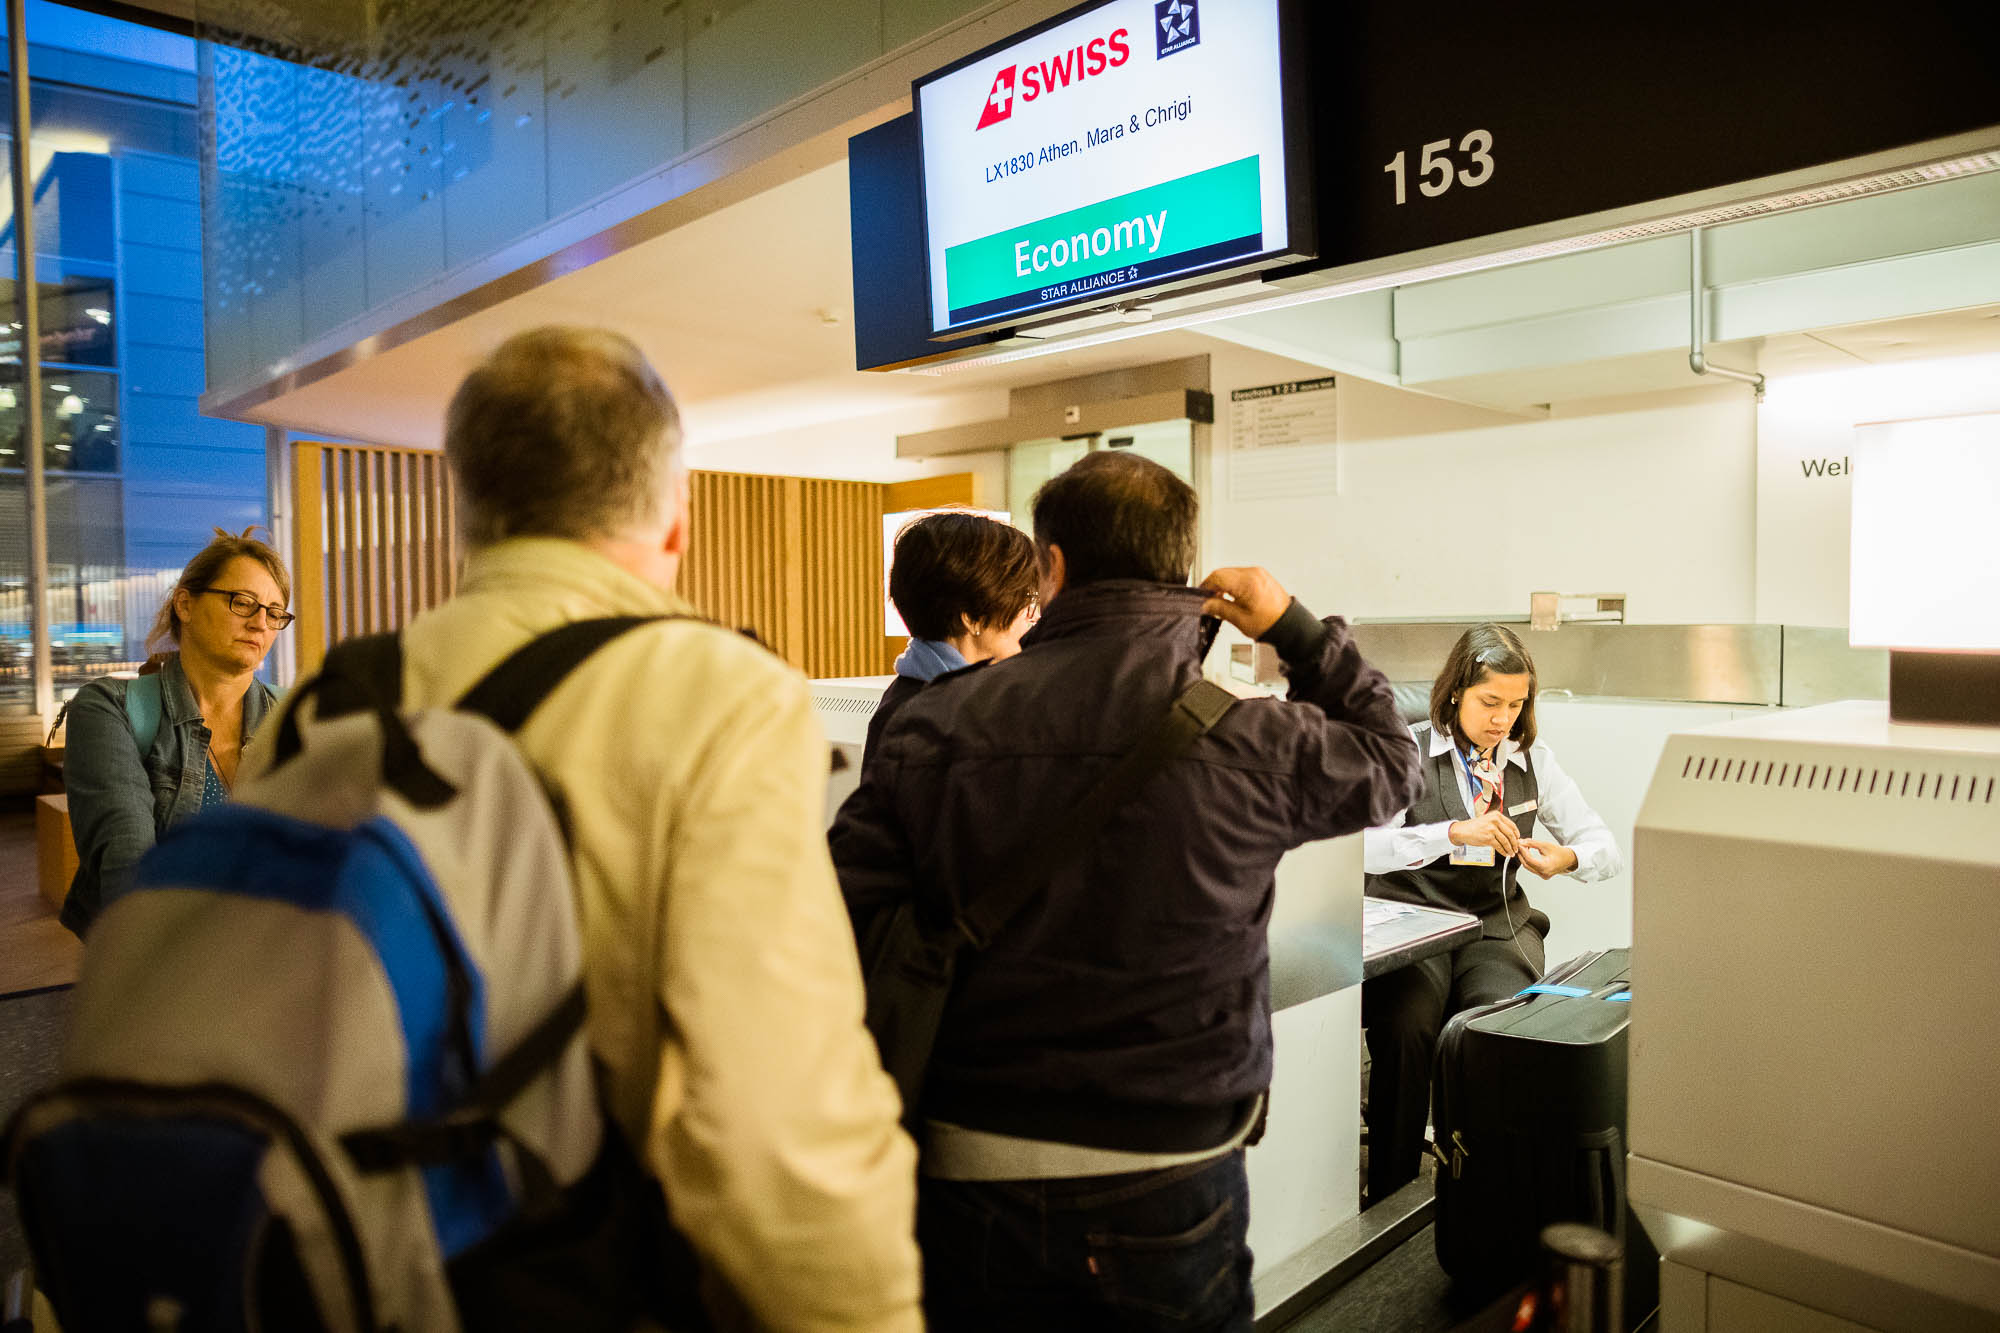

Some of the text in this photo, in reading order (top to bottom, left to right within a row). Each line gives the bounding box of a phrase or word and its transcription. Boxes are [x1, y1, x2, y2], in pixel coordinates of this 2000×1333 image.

[1022, 28, 1130, 102] SWISS
[1161, 36, 1196, 55] STAR ALLIANCE
[985, 95, 1192, 183] LX1830 Athen, Mara & Chrigi
[1384, 129, 1495, 205] 153
[1014, 209, 1168, 278] Economy
[1041, 270, 1125, 301] STAR ALLIANCE
[1801, 456, 1853, 478] Wel
